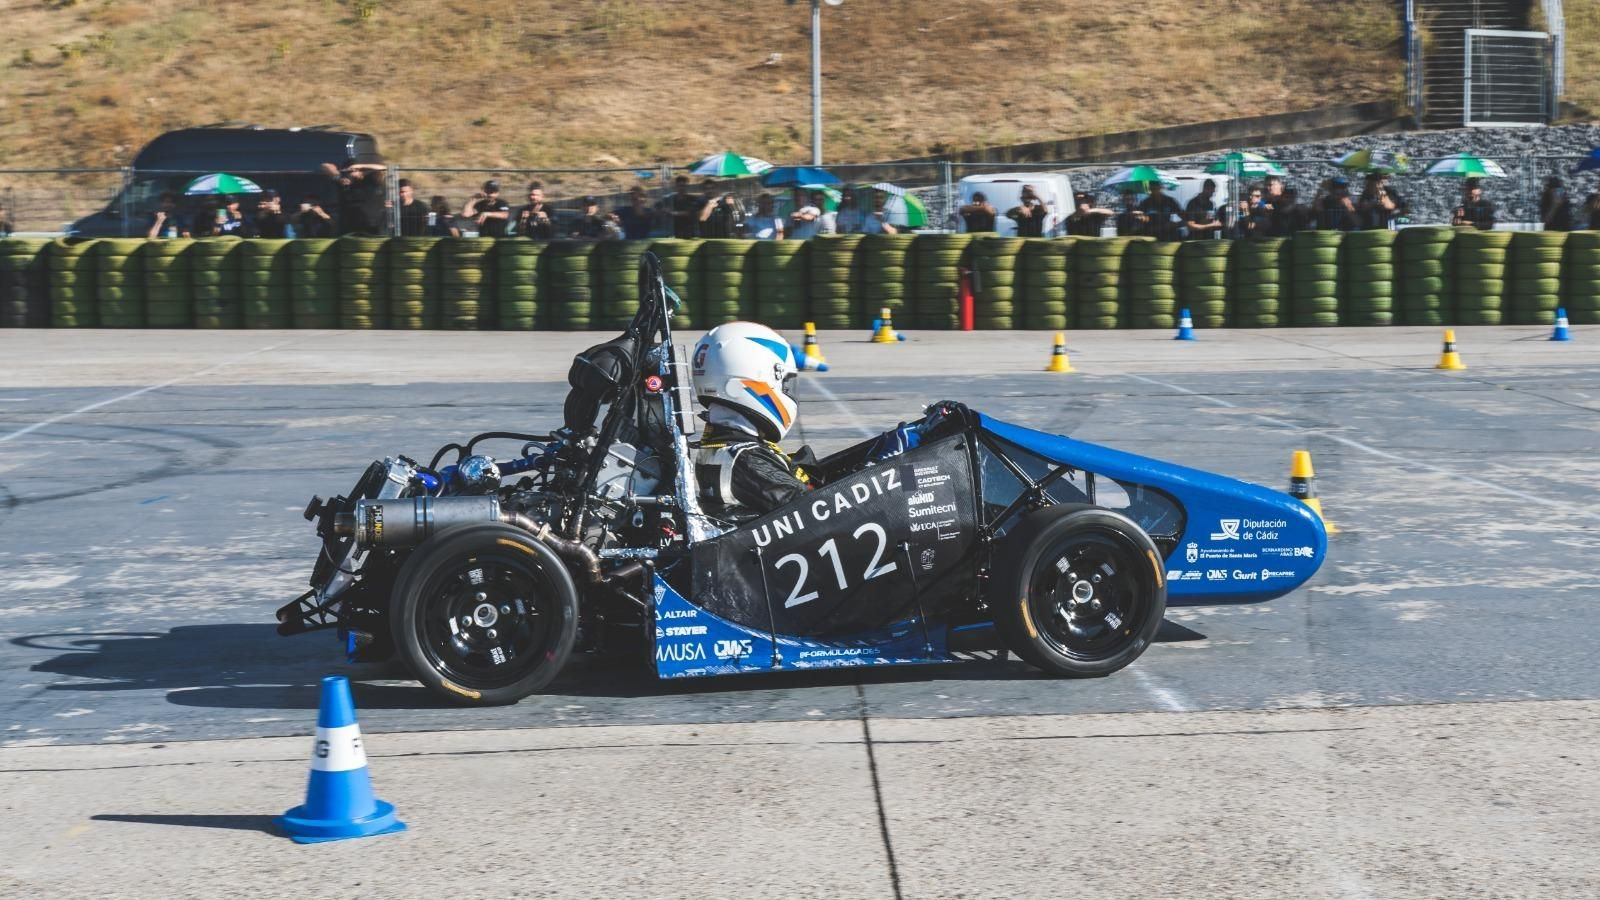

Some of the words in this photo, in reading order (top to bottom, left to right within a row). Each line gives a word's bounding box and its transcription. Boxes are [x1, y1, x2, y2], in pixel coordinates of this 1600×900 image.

[751, 511, 805, 547] UNI
[811, 468, 902, 521] CADIZ
[908, 502, 957, 518] Sumitecni
[921, 521, 937, 531] UCA
[1242, 518, 1287, 529] Diputación
[1242, 531, 1254, 540] de
[1255, 530, 1279, 540] Cádiz
[660, 538, 672, 547] LV
[774, 522, 898, 609] 212
[1232, 569, 1258, 580] Gurit
[664, 610, 698, 619] ALTAIR
[665, 625, 708, 636] STAYER
